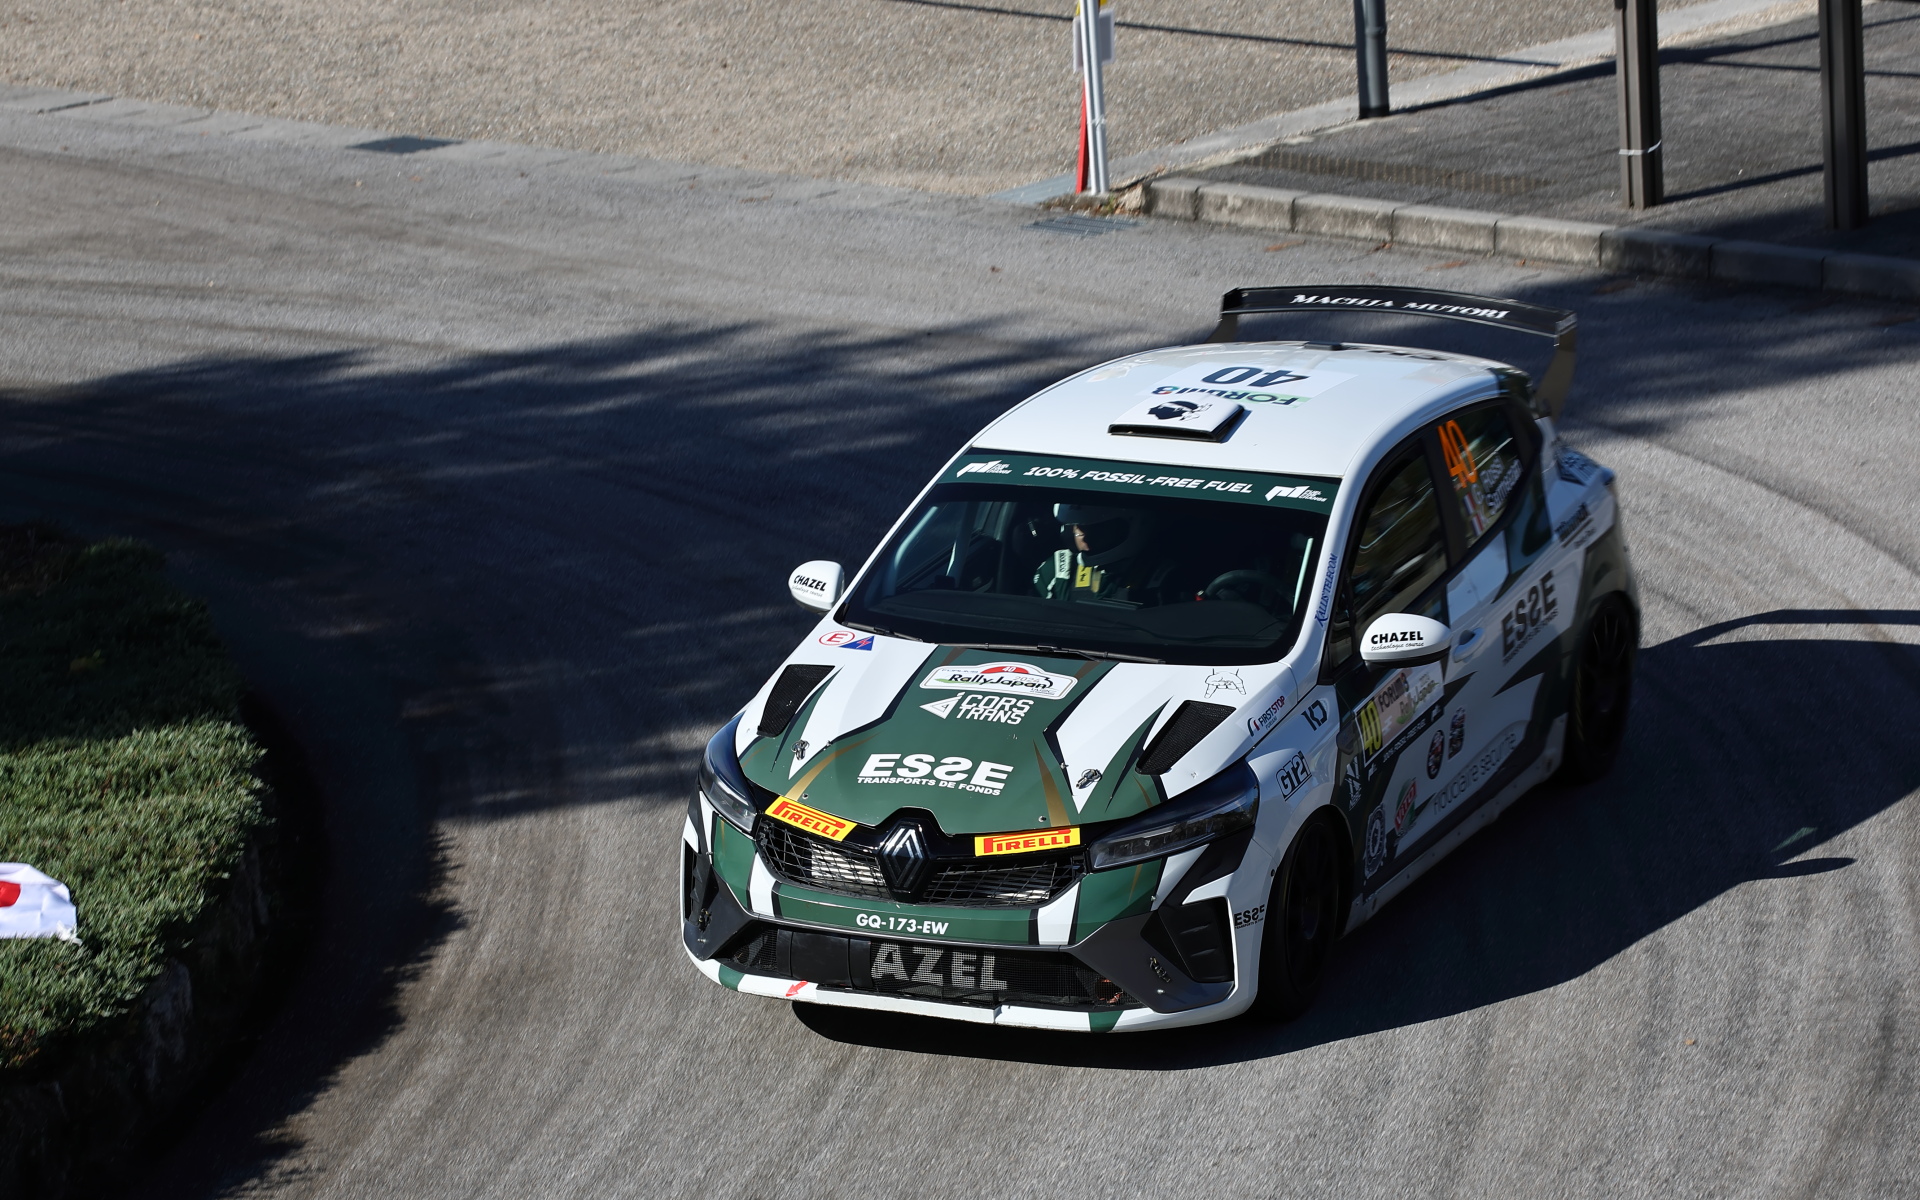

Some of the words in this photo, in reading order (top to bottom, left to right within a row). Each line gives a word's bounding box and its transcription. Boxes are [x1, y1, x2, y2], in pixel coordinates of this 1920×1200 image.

[1401, 302, 1511, 319] MUTORI
[1202, 366, 1311, 387] 40
[1437, 419, 1478, 488] 40
[1022, 466, 1082, 479] 100%
[1080, 471, 1206, 489] FOSSIL-FREE
[1202, 480, 1254, 494] FUEL
[794, 575, 827, 592] CHAZEL
[827, 633, 848, 643] E
[1371, 631, 1424, 645] CHAZEL
[960, 694, 1035, 714] CORS
[956, 706, 1026, 725] TRANS
[1360, 700, 1382, 756] 40
[858, 753, 1014, 790] ESSE
[857, 776, 937, 786] TRANSPORTS
[938, 780, 956, 789] DE
[958, 783, 1002, 796] FONDS
[773, 801, 846, 838] PIRELLI
[983, 828, 1071, 854] PIRELLI
[856, 913, 949, 935] GQ-173-EW
